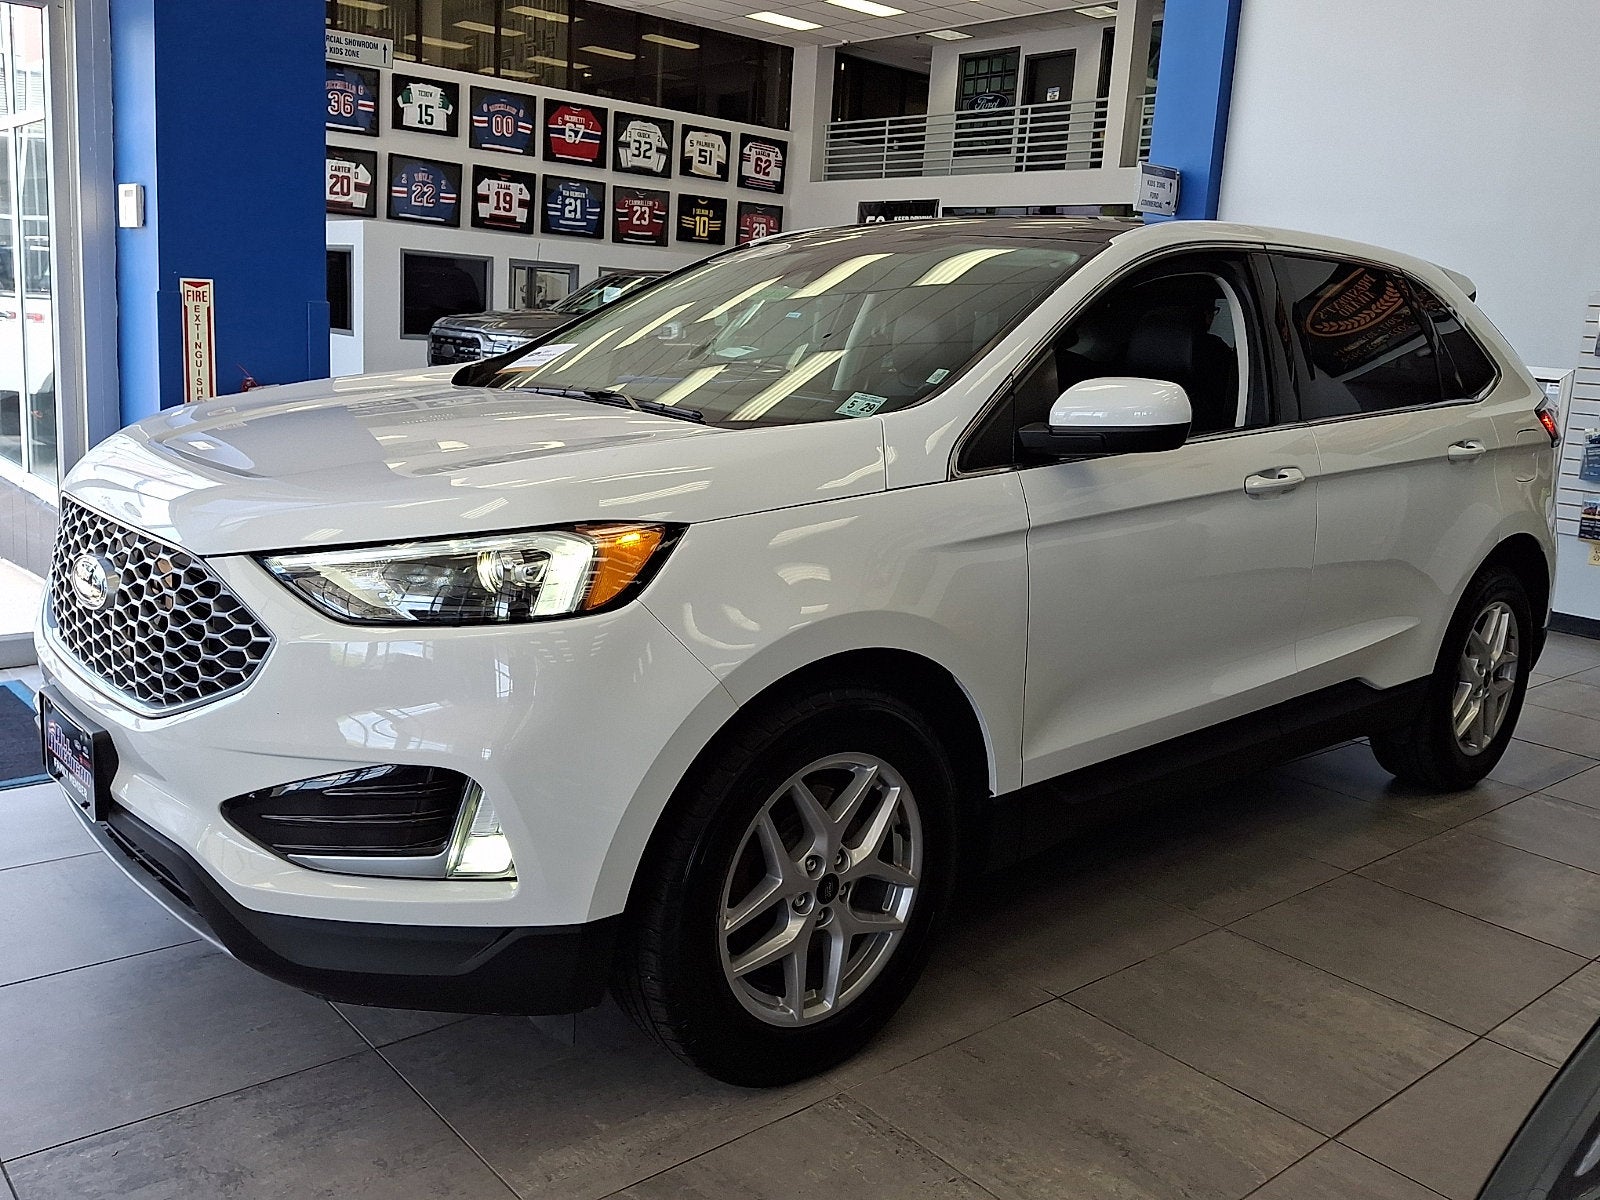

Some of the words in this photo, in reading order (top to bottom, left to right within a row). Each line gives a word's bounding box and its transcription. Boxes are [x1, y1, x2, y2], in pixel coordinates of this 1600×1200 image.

[330, 47, 343, 55] KIDS
[345, 49, 360, 58] ZONE
[345, 38, 379, 50] SHOWROOM
[328, 91, 354, 117] 36
[975, 95, 1001, 110] Ford
[417, 103, 434, 126] 15
[492, 114, 514, 137] 00
[565, 123, 585, 144] 67
[632, 139, 652, 159] 32
[698, 148, 713, 165] 51
[331, 165, 351, 173] CARTER
[754, 157, 772, 177] 62
[329, 174, 351, 196] 20
[412, 183, 435, 207] 22
[494, 191, 513, 212] 19
[565, 198, 581, 219] 21
[633, 206, 649, 225] 23
[696, 216, 708, 237] 10
[753, 223, 766, 238] 28
[186, 290, 208, 302] FIRE
[847, 400, 858, 409] 5
[860, 403, 876, 412] 29
